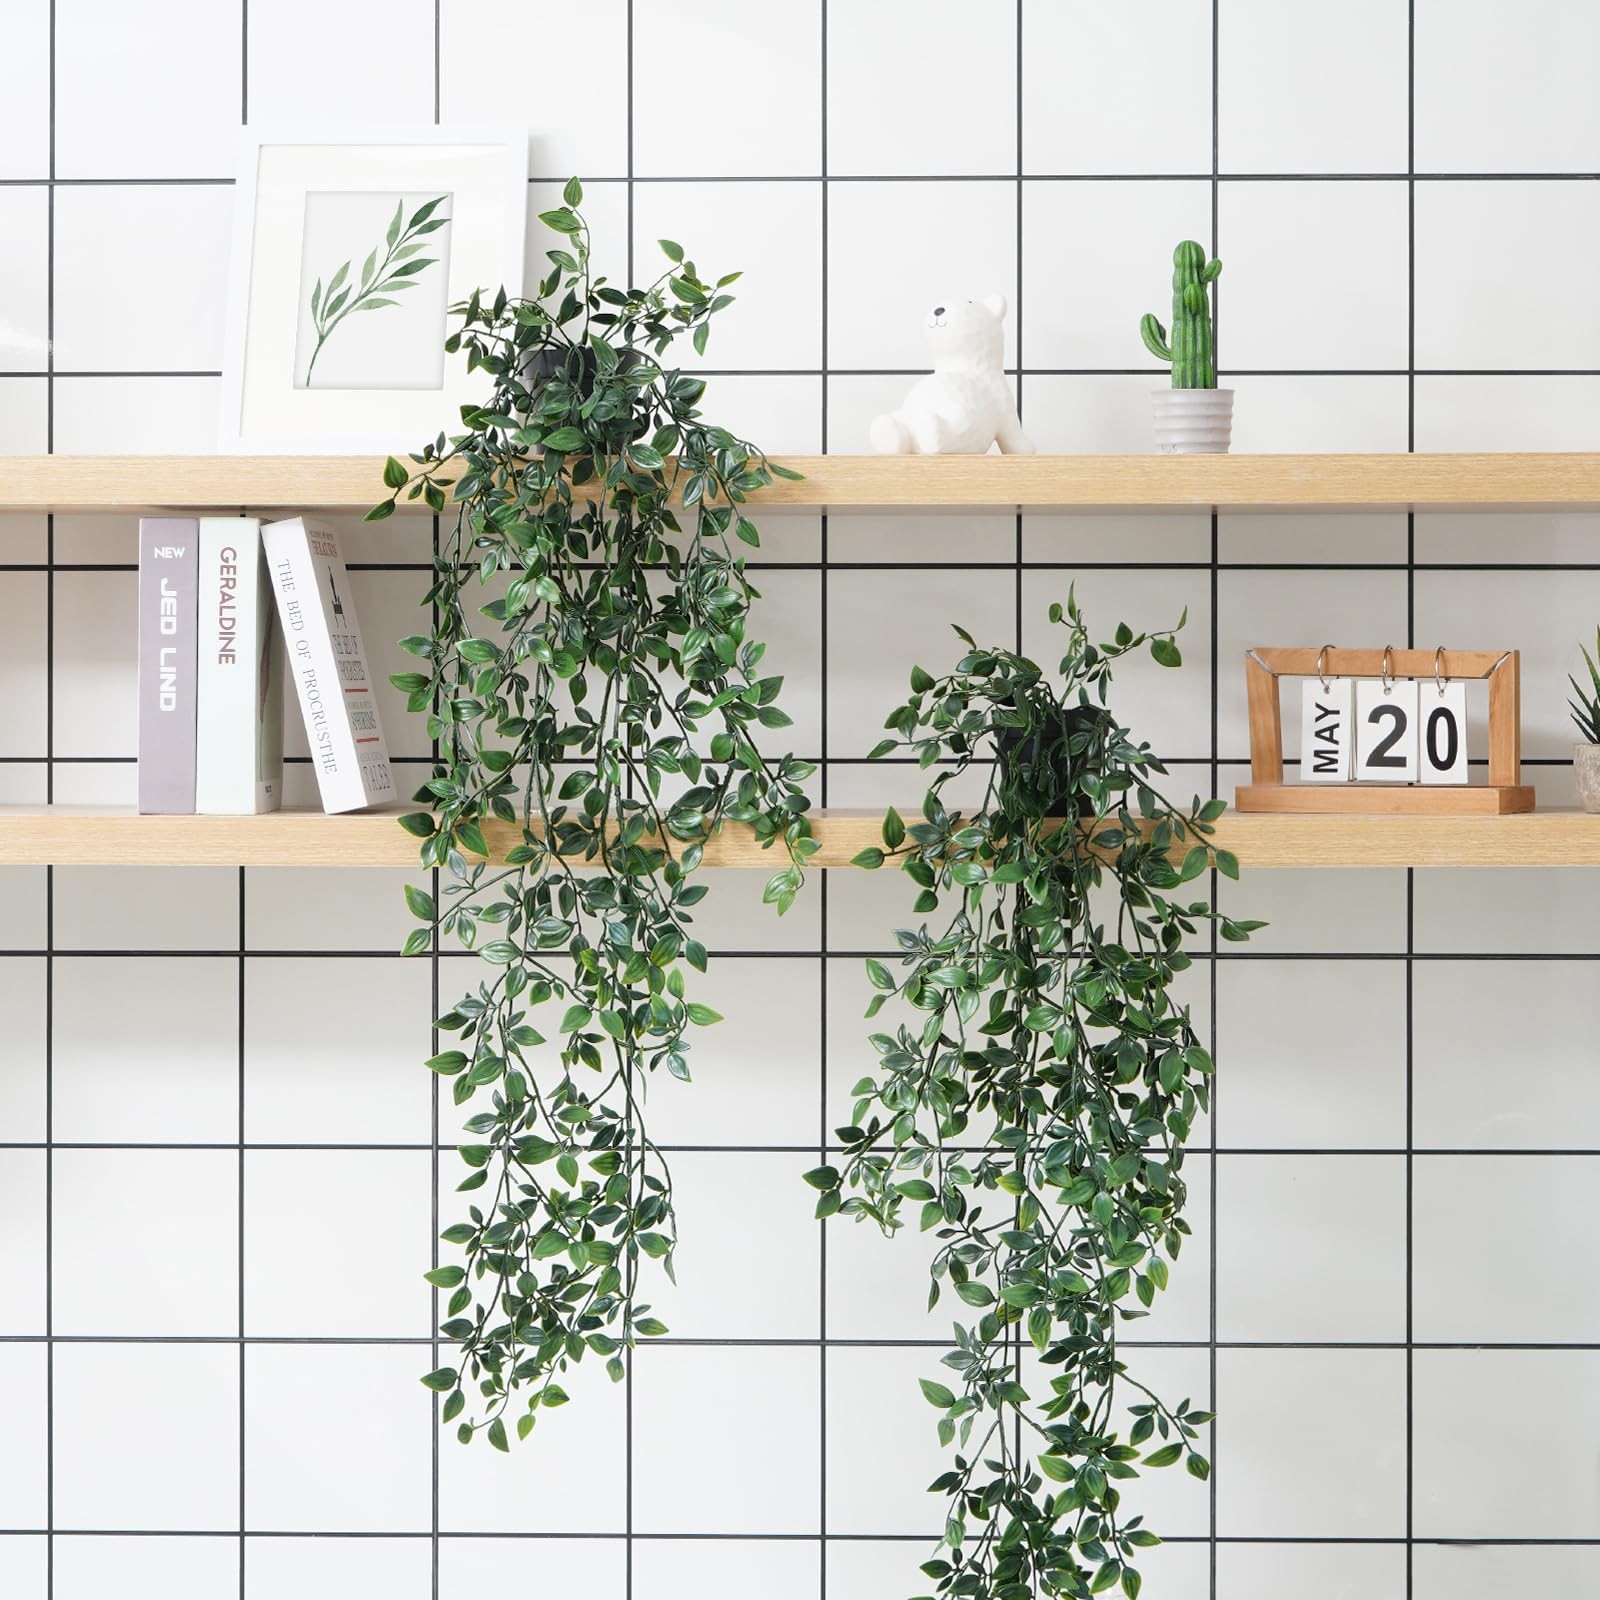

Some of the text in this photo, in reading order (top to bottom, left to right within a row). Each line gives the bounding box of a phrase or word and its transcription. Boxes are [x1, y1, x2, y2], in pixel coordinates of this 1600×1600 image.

[154, 546, 186, 559] NEW
[218, 546, 238, 665] GERALDINE
[159, 576, 177, 712] JED LIND
[277, 558, 338, 776] THE BED OF PROCRUSTHE
[1313, 702, 1341, 774] MAY
